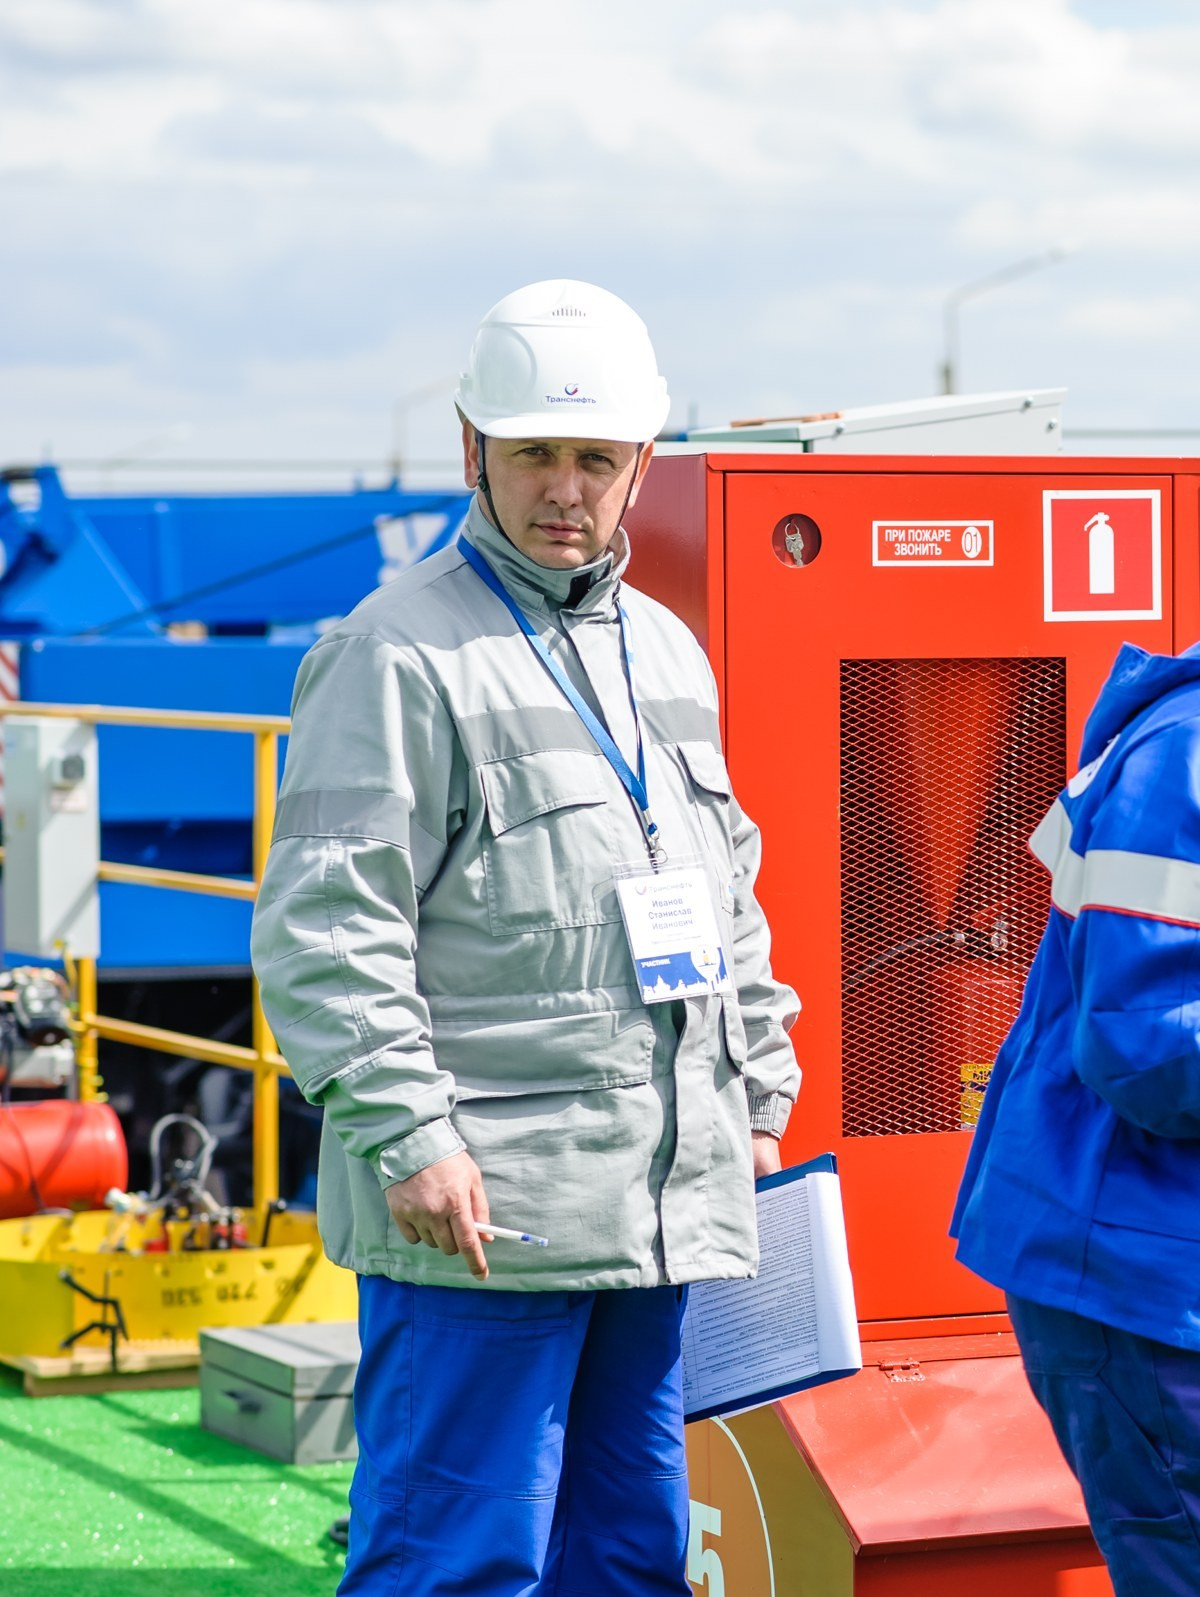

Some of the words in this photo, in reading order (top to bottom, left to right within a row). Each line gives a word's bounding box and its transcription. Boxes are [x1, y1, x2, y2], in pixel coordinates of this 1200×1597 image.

[545, 395, 597, 404] Транснефть
[885, 529, 906, 542] ПРИ
[908, 529, 951, 542] ПОЖАРЕ
[964, 531, 978, 553] 01
[894, 543, 942, 556] ЗВОНИТЬ
[651, 898, 683, 908] Иванов
[648, 908, 692, 920] Станислав
[652, 919, 693, 931] Иванович
